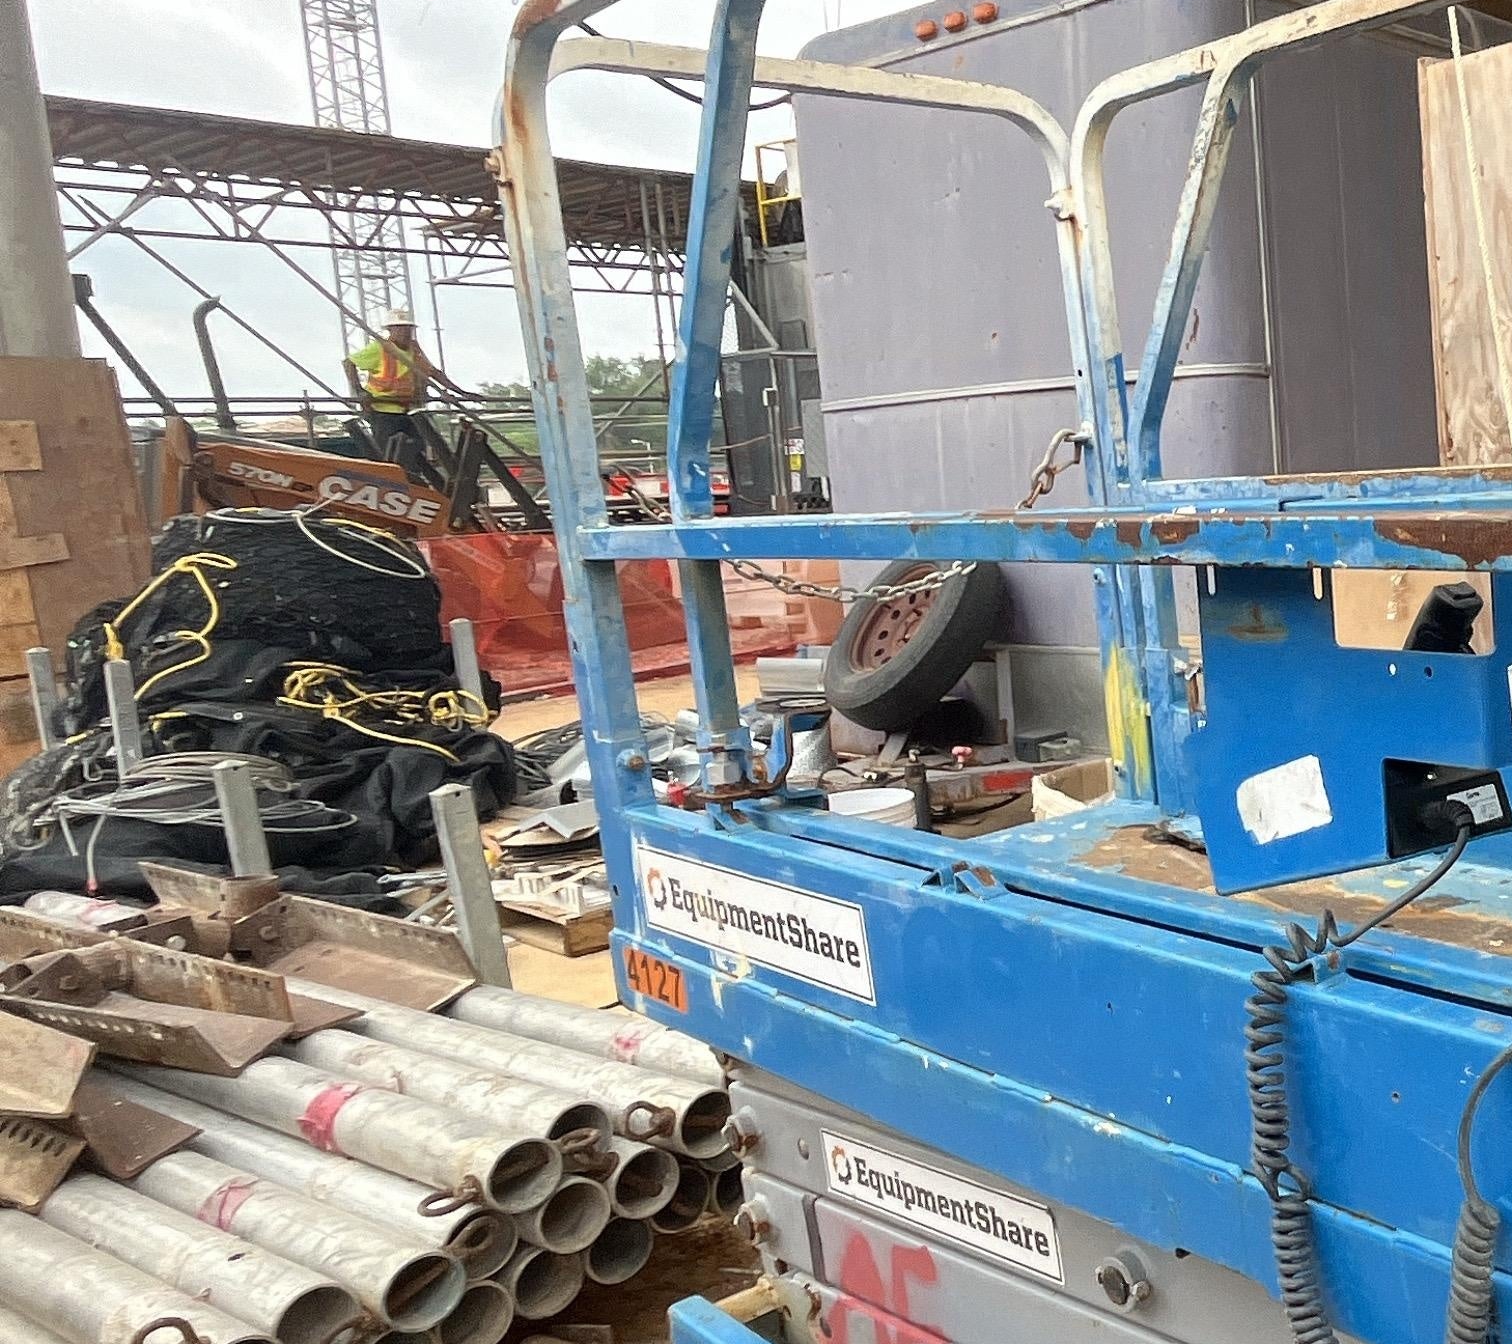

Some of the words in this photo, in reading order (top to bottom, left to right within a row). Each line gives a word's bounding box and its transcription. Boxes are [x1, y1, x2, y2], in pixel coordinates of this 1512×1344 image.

[227, 461, 295, 488] 570N
[317, 475, 442, 524] CASE
[668, 877, 861, 968] EquipmentShare
[626, 948, 683, 1008] 4127
[853, 1156, 1050, 1257] EquipmentShare
